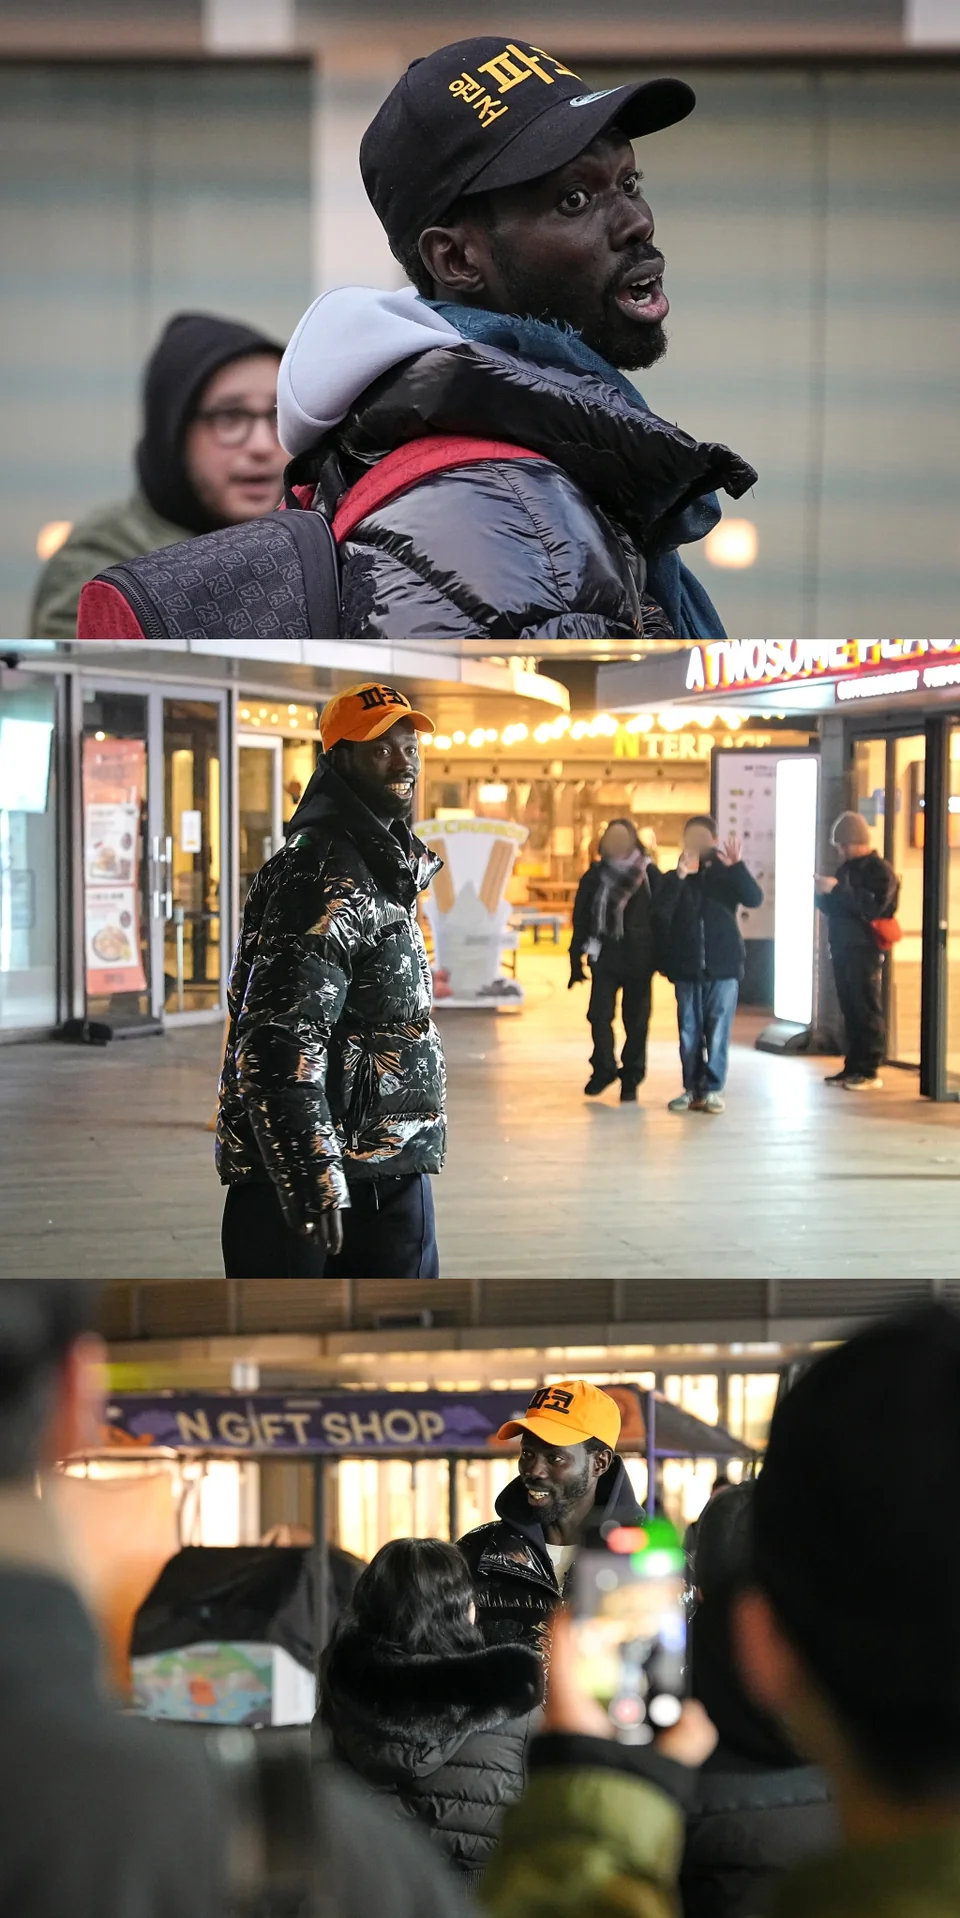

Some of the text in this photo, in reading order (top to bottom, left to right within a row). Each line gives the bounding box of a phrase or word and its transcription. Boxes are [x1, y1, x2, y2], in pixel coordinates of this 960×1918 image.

[448, 72, 509, 129] 원조
[706, 638, 848, 687] TWOSOME
[357, 686, 408, 710] 파코
[527, 1387, 574, 1414] 파코
[176, 1409, 446, 1446] N GIFT SHOP
